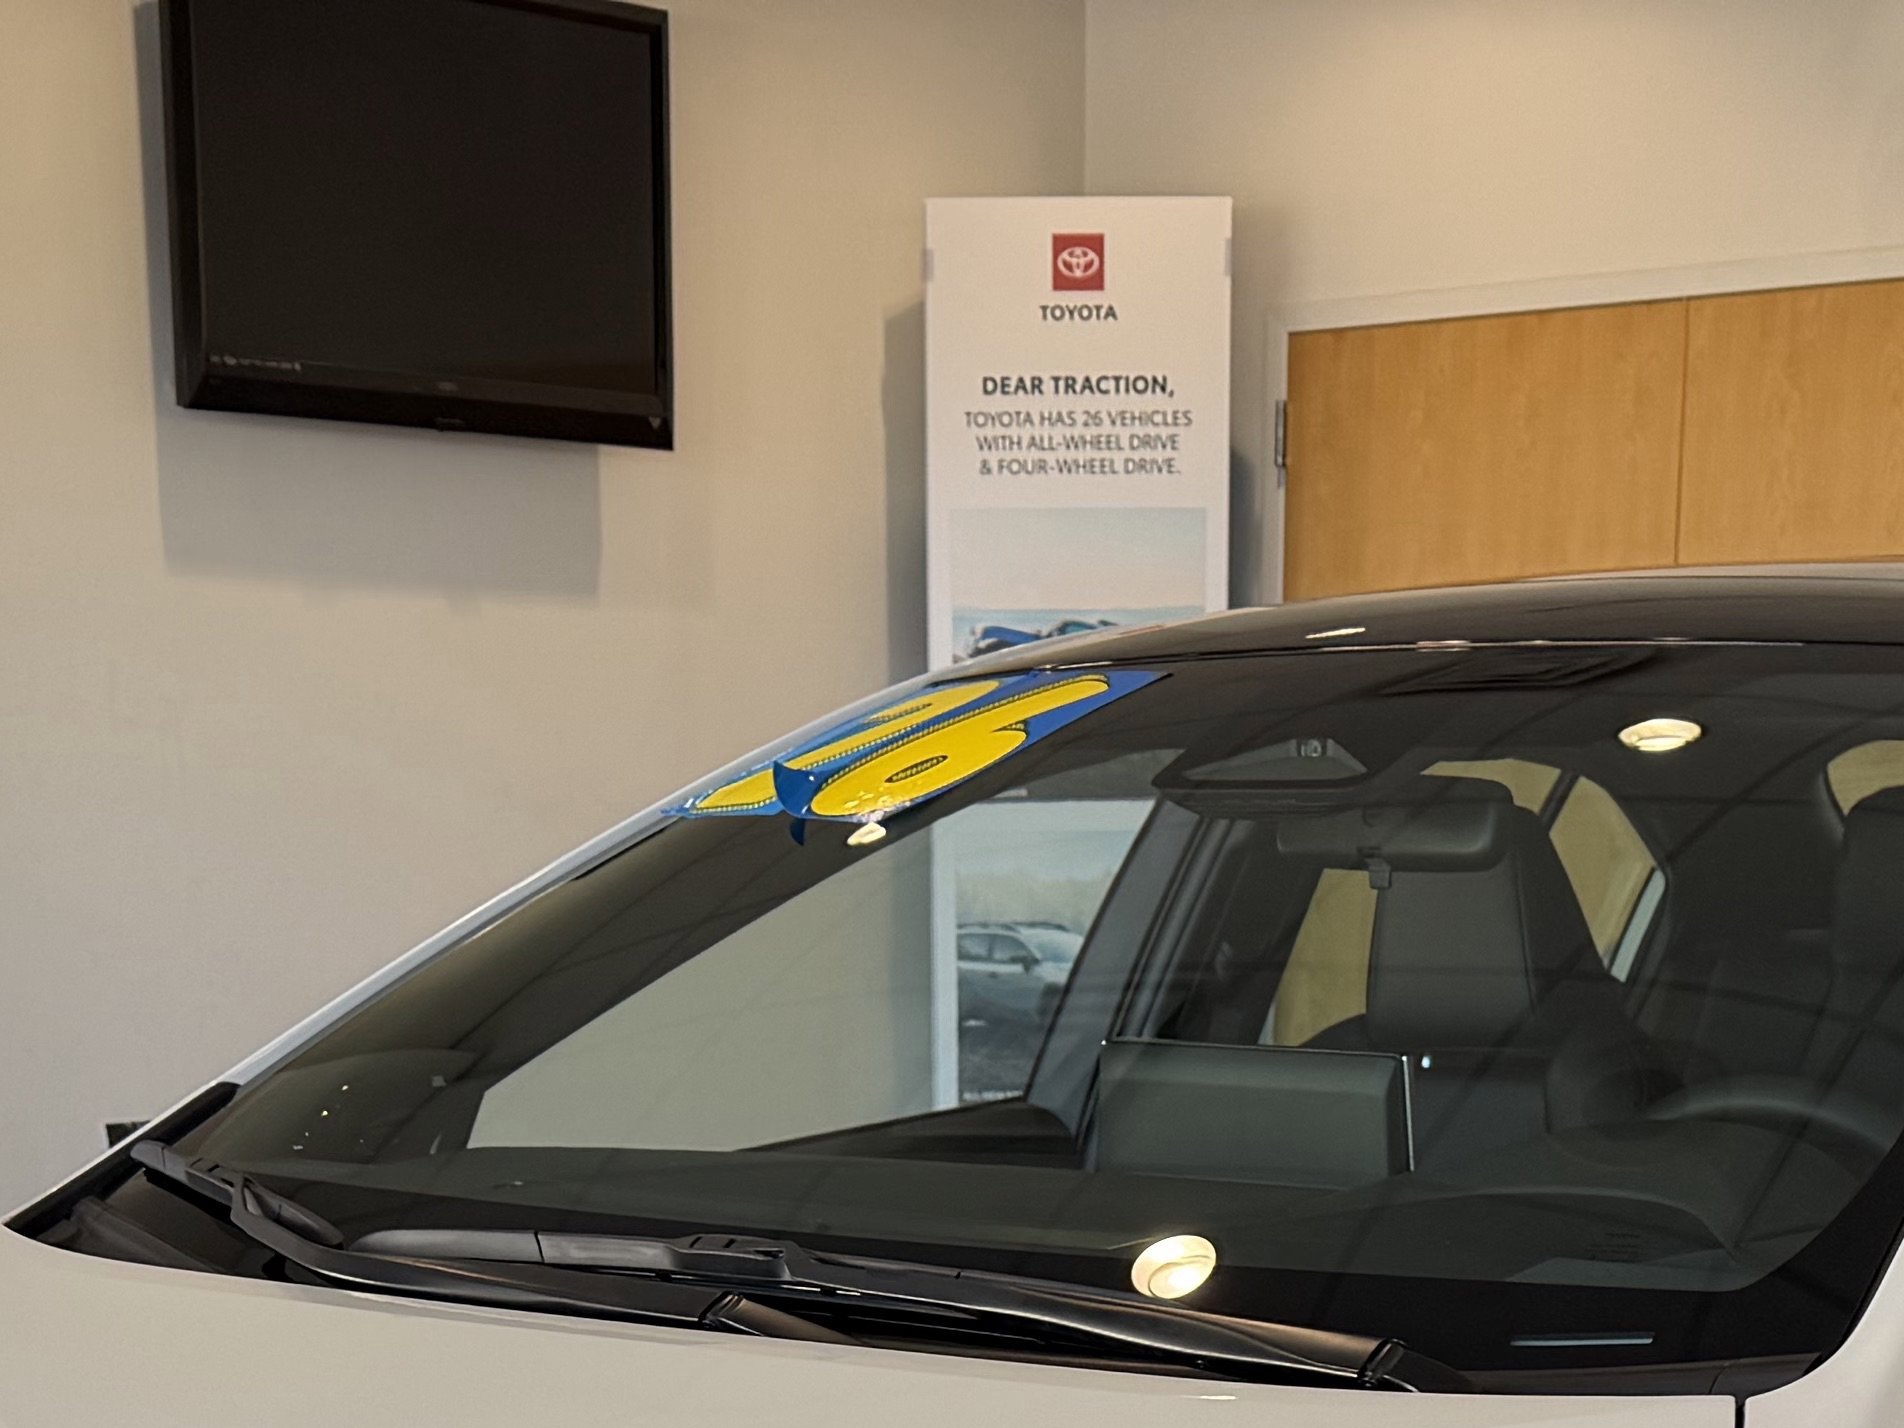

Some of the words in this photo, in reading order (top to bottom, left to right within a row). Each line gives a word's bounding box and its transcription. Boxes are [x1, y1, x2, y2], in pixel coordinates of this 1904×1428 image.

[1039, 304, 1118, 321] TOYOTA
[982, 376, 1043, 396] DEAR
[1051, 375, 1174, 398] TRACTION,
[964, 411, 1034, 428] TOYOTA
[1039, 411, 1077, 427] HAS
[1082, 411, 1103, 427] 26
[1107, 410, 1193, 427] VEHICLES
[976, 434, 1022, 451] WITH
[1026, 434, 1124, 451] ALL-WHEEL
[1129, 434, 1180, 450] DRIVE
[979, 460, 992, 476] &
[997, 459, 1119, 476] FOUR-WHEEL
[1124, 458, 1181, 475] DRIVE.
